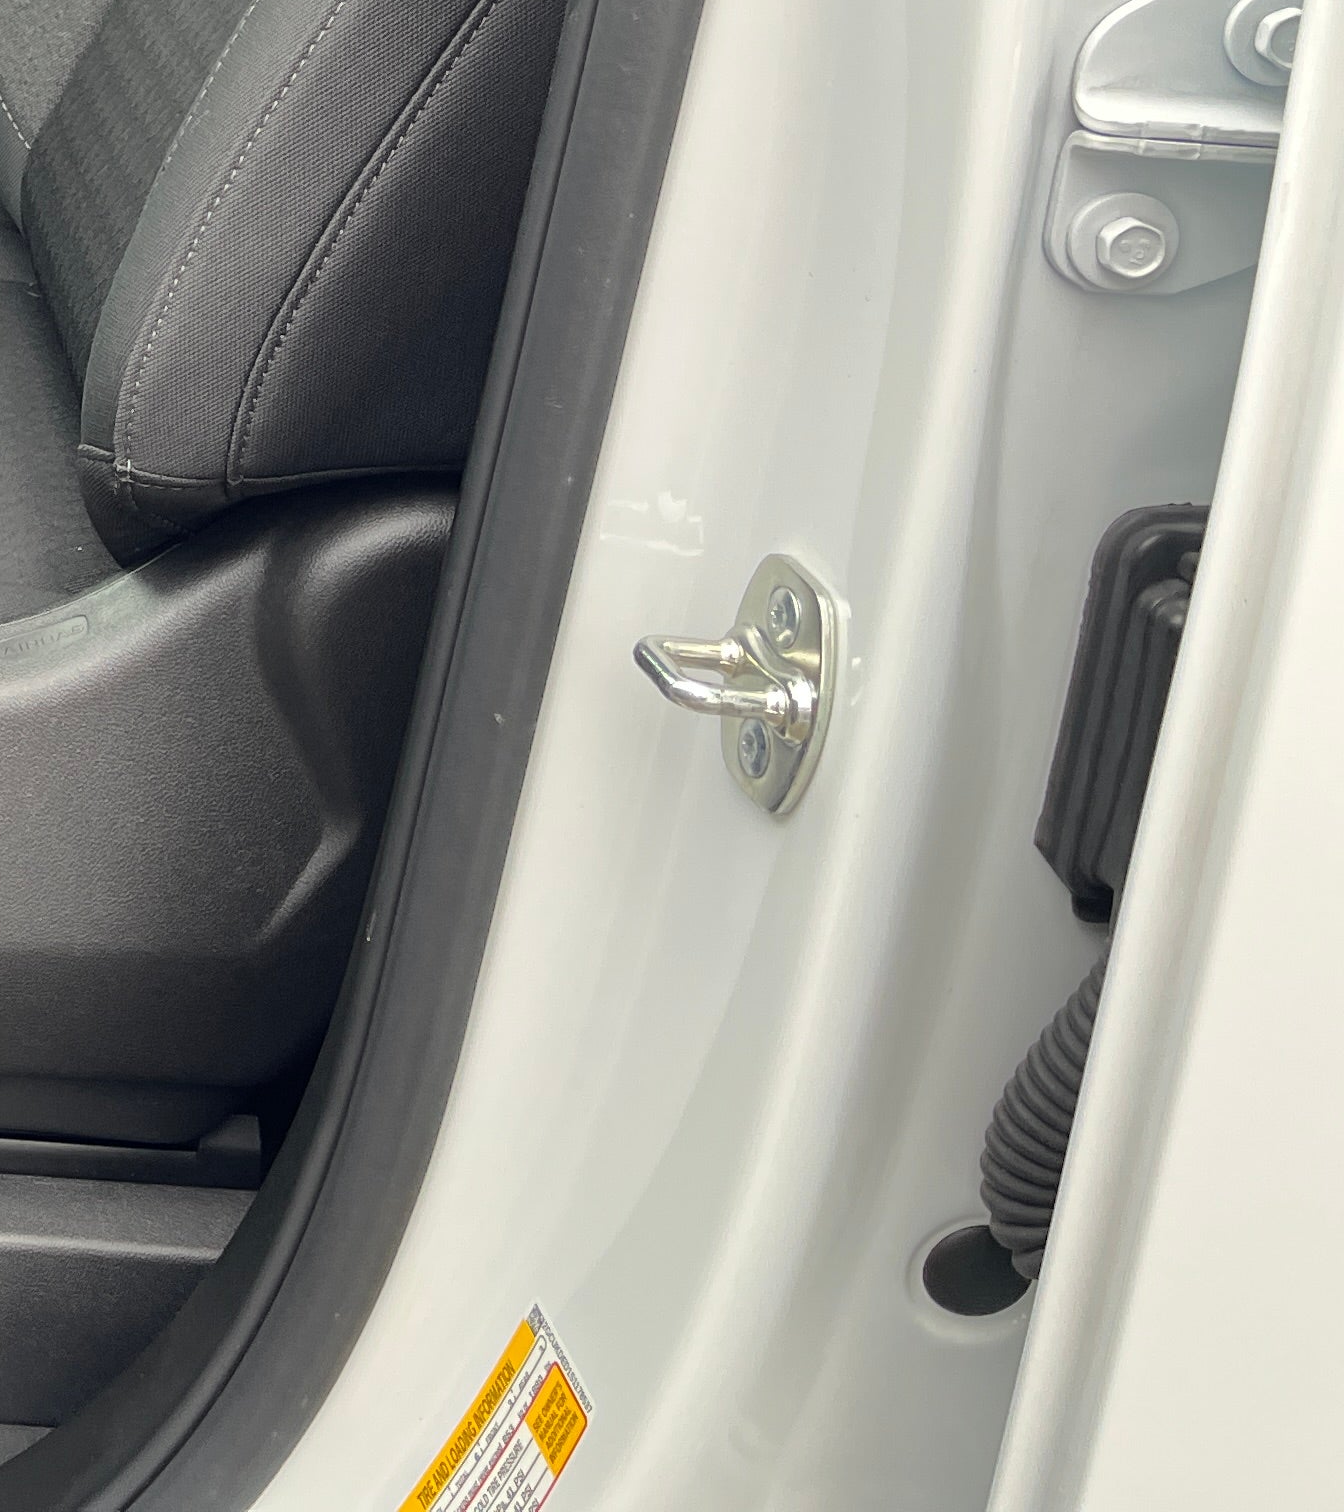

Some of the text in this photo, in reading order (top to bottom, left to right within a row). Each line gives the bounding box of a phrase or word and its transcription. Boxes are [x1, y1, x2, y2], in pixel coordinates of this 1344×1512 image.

[416, 1479, 437, 1511] TIRE
[432, 1461, 450, 1491] AND
[445, 1421, 477, 1470] LOADING
[472, 1357, 516, 1429] INFORMATION
[549, 1409, 579, 1465] INFORMATION
[487, 1475, 500, 1497] TIRE
[497, 1438, 523, 1481] PRESSURE
[513, 1468, 526, 1489] PSI
[520, 1483, 535, 1503] PSI
